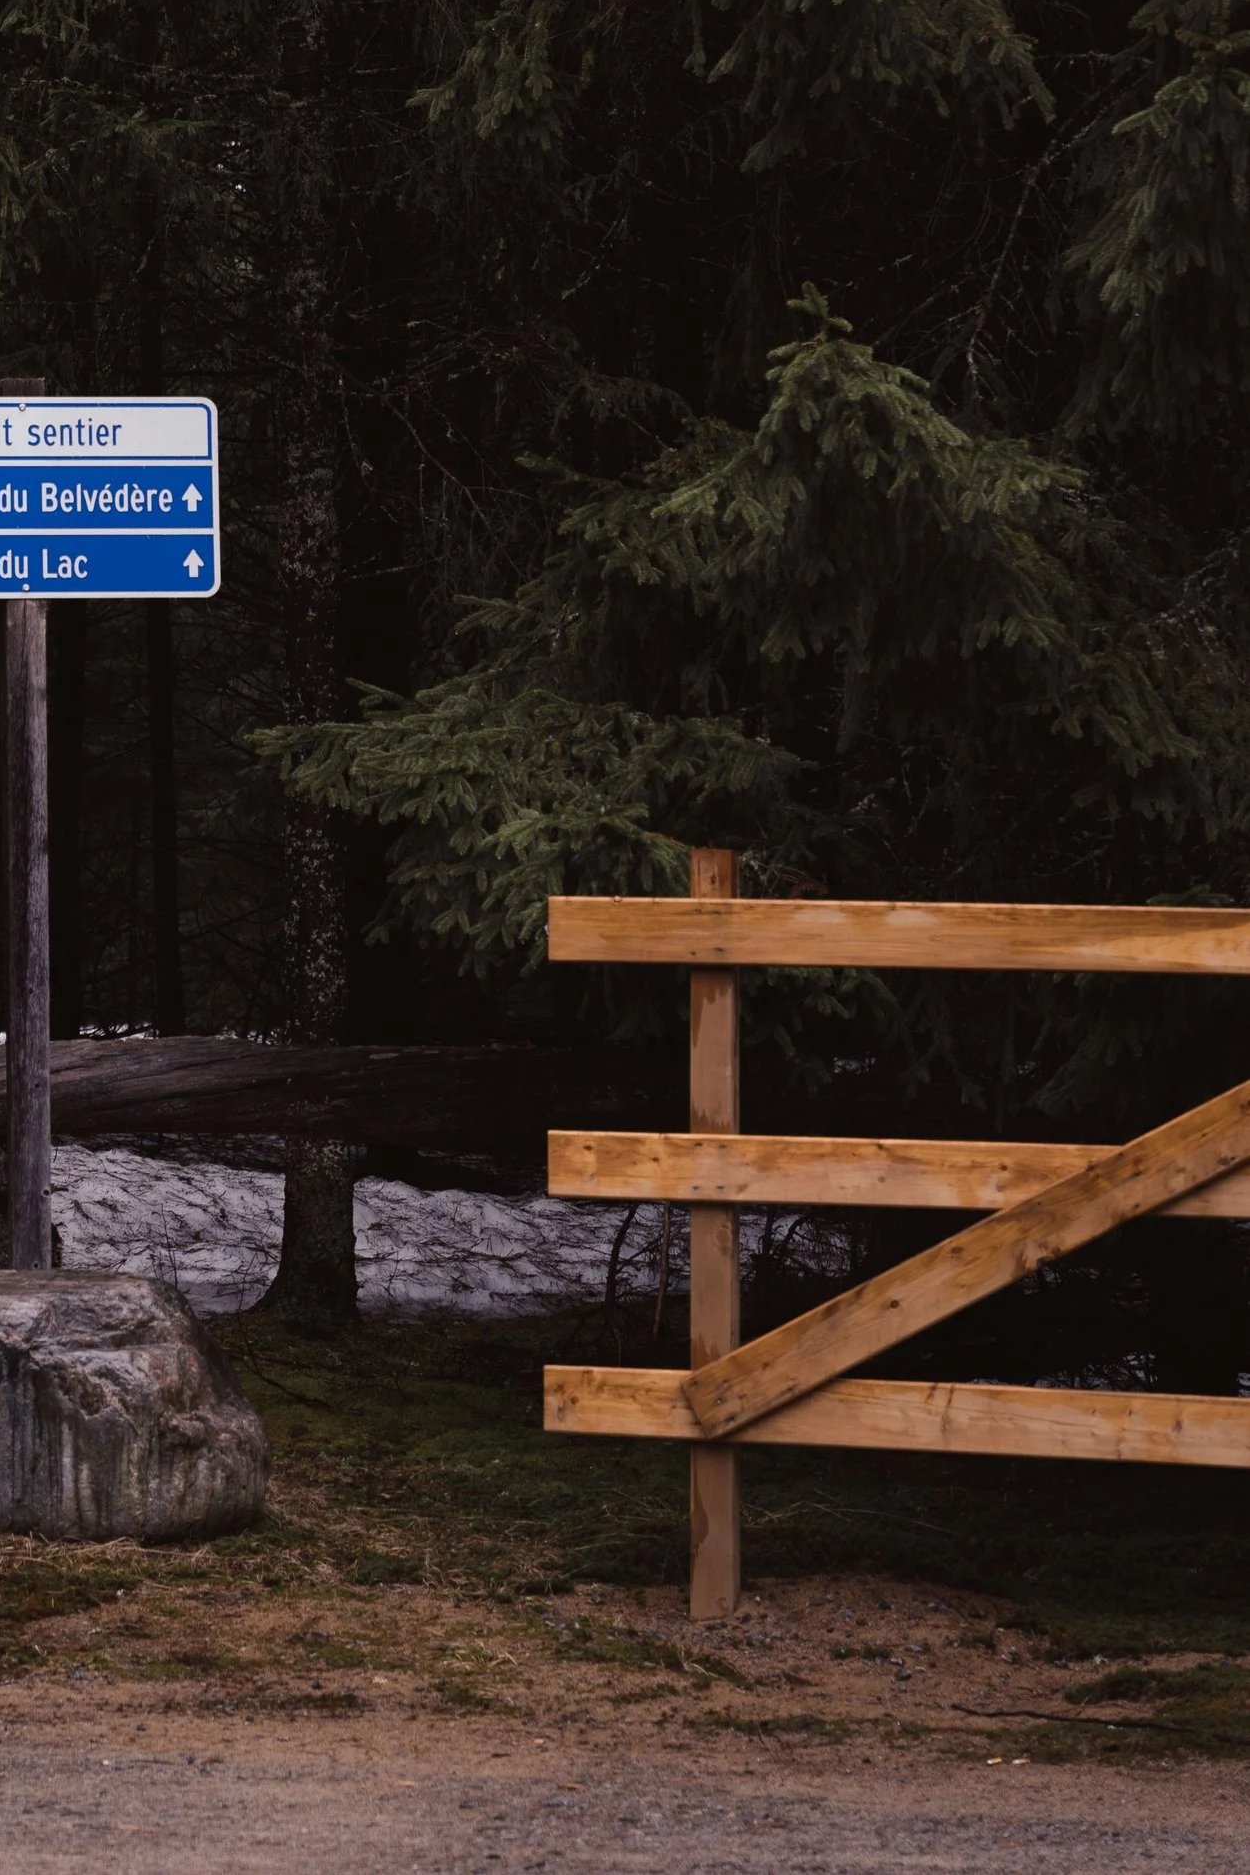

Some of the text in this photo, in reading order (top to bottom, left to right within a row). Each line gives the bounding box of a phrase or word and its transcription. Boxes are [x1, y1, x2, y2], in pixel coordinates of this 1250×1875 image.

[27, 418, 123, 447] sentier
[41, 482, 173, 513] Belvédère
[42, 548, 88, 579] Lac
